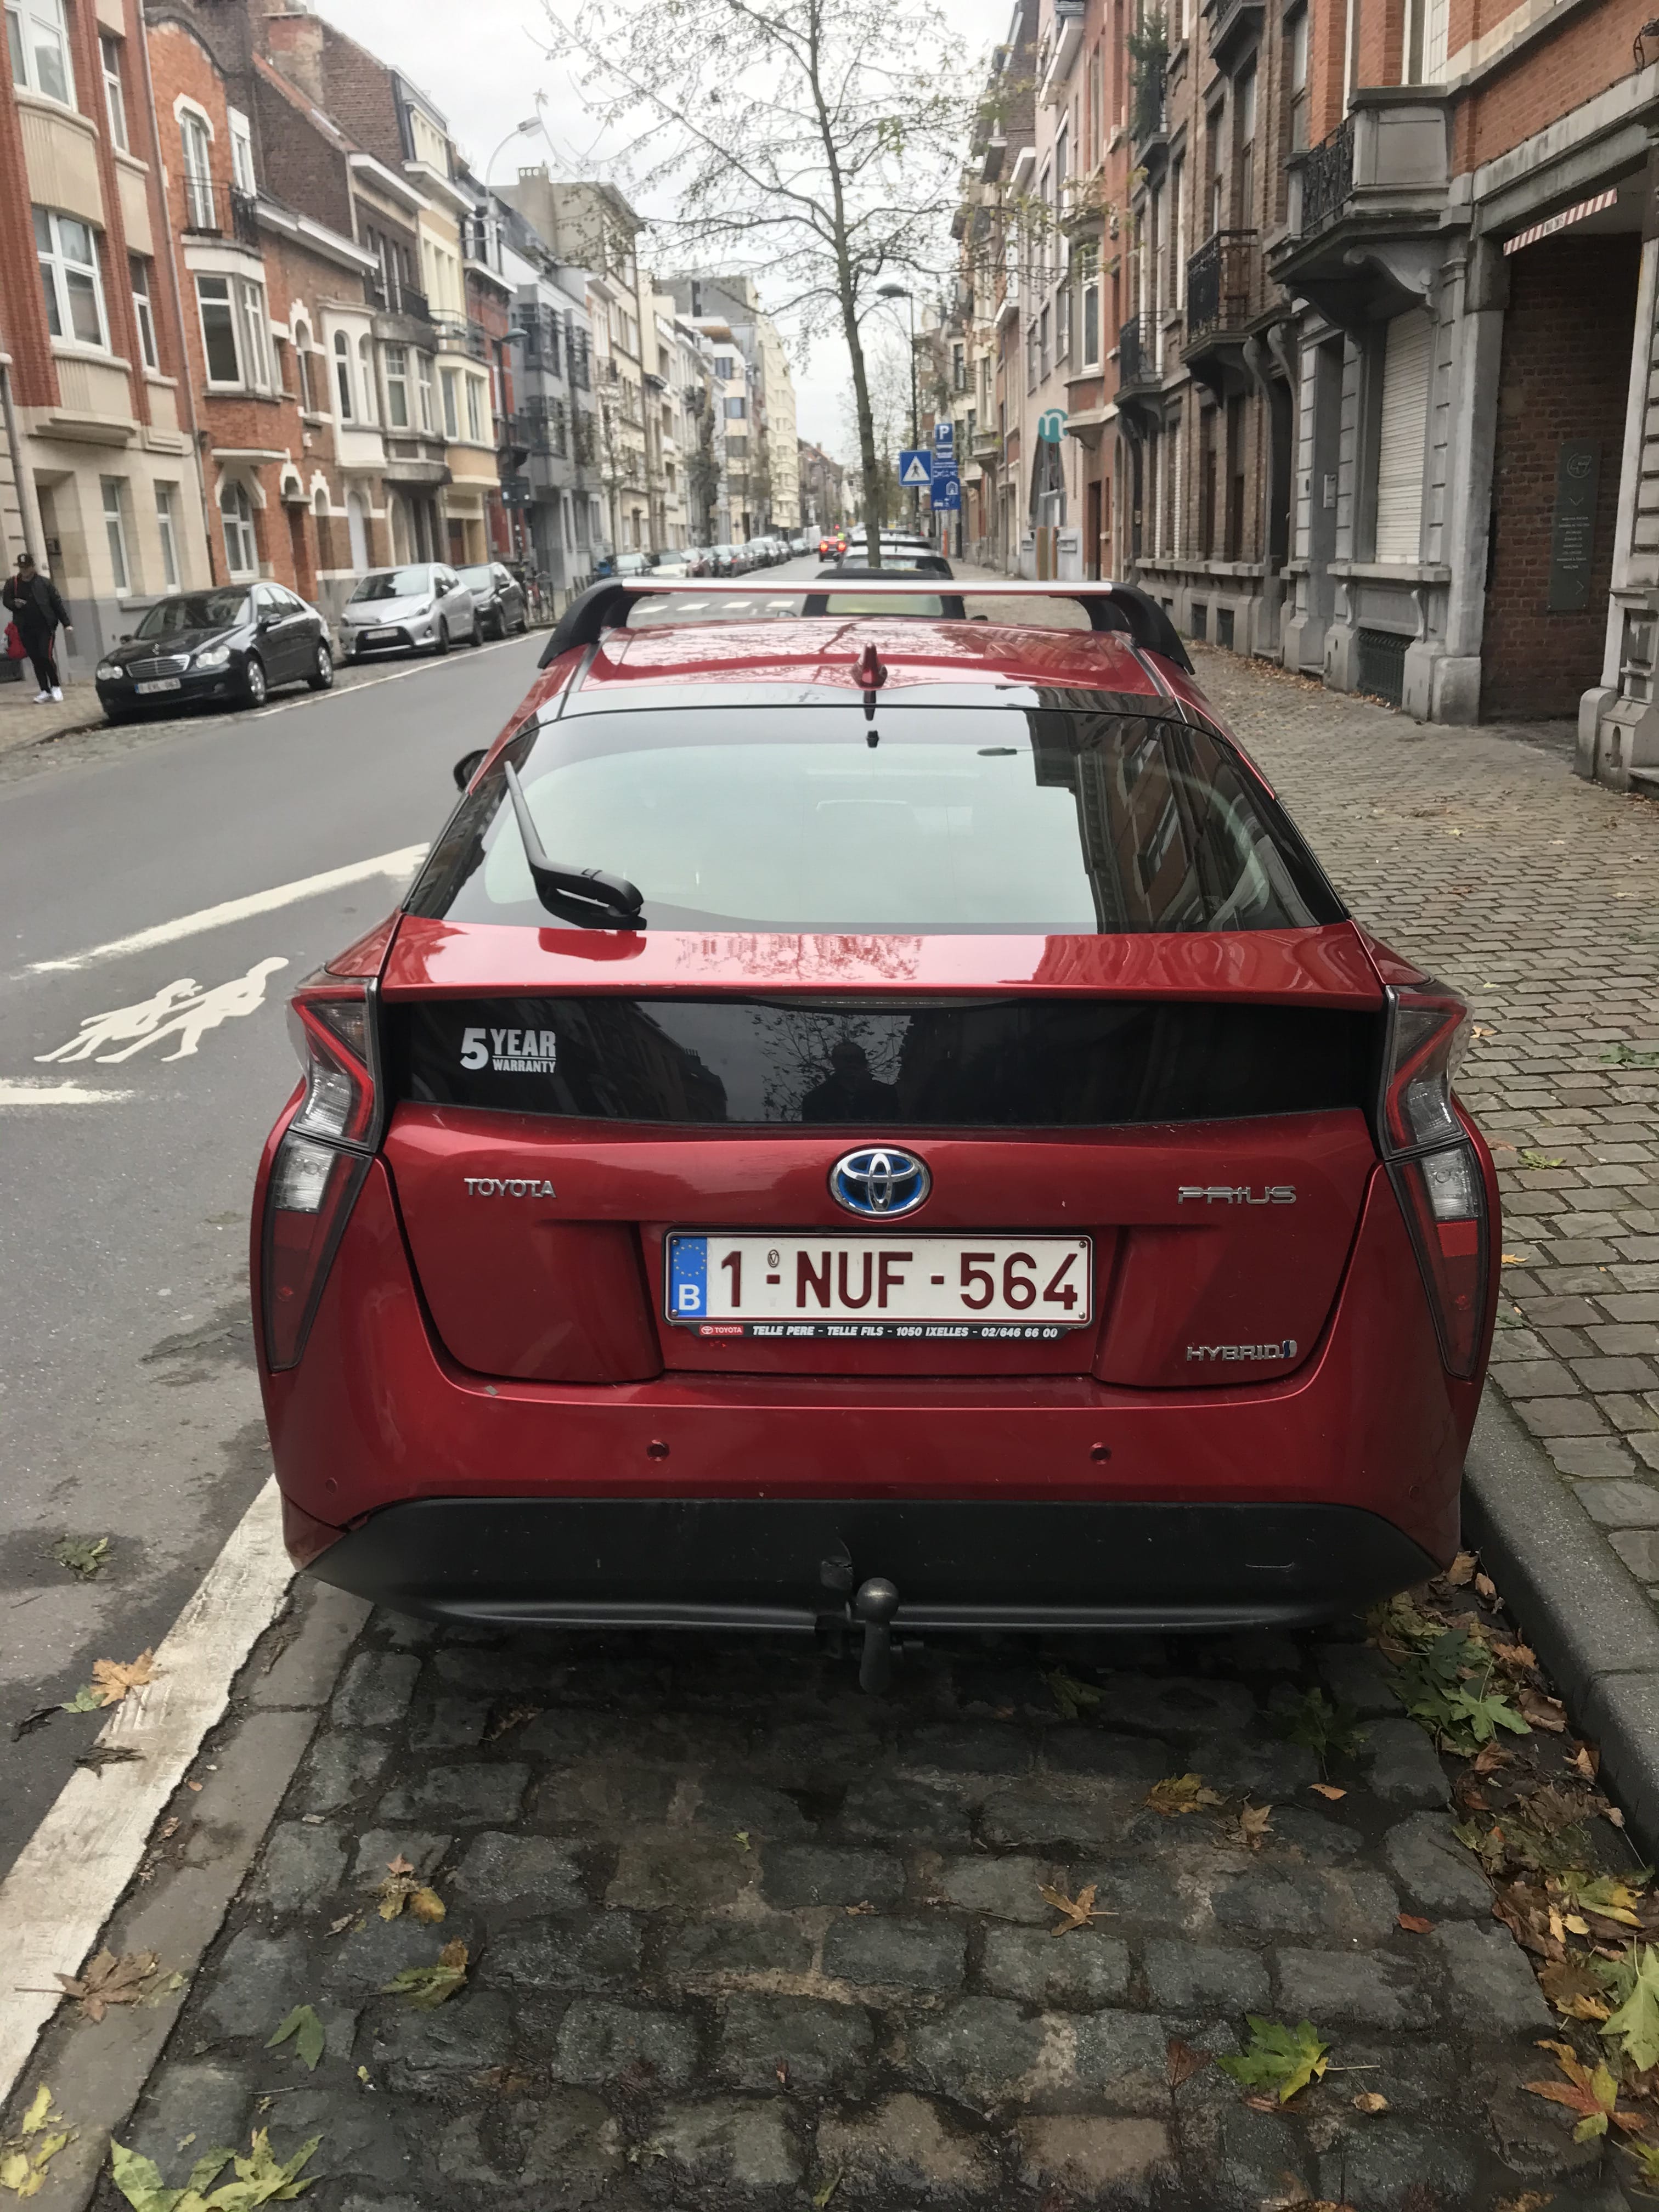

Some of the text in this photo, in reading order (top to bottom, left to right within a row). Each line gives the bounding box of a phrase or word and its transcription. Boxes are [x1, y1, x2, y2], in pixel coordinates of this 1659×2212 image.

[939, 425, 950, 440] P
[460, 1028, 556, 1070] 5 YEAR
[493, 1059, 556, 1073] WARRANTY
[464, 1178, 556, 1198] TOYOTA
[1177, 1186, 1297, 1205] PRIUS
[679, 1284, 701, 1310] B
[753, 1325, 783, 1335] TELLE
[786, 1326, 815, 1335] PERE
[827, 1326, 858, 1336] TELLE
[861, 1327, 883, 1336] FILS
[896, 1327, 923, 1336] 1050
[926, 1327, 968, 1336] IXELLES
[981, 1327, 1020, 1338] 02/646
[1025, 1328, 1039, 1338] 66
[1043, 1328, 1058, 1338] 00
[1186, 1345, 1283, 1362] HYBRID
